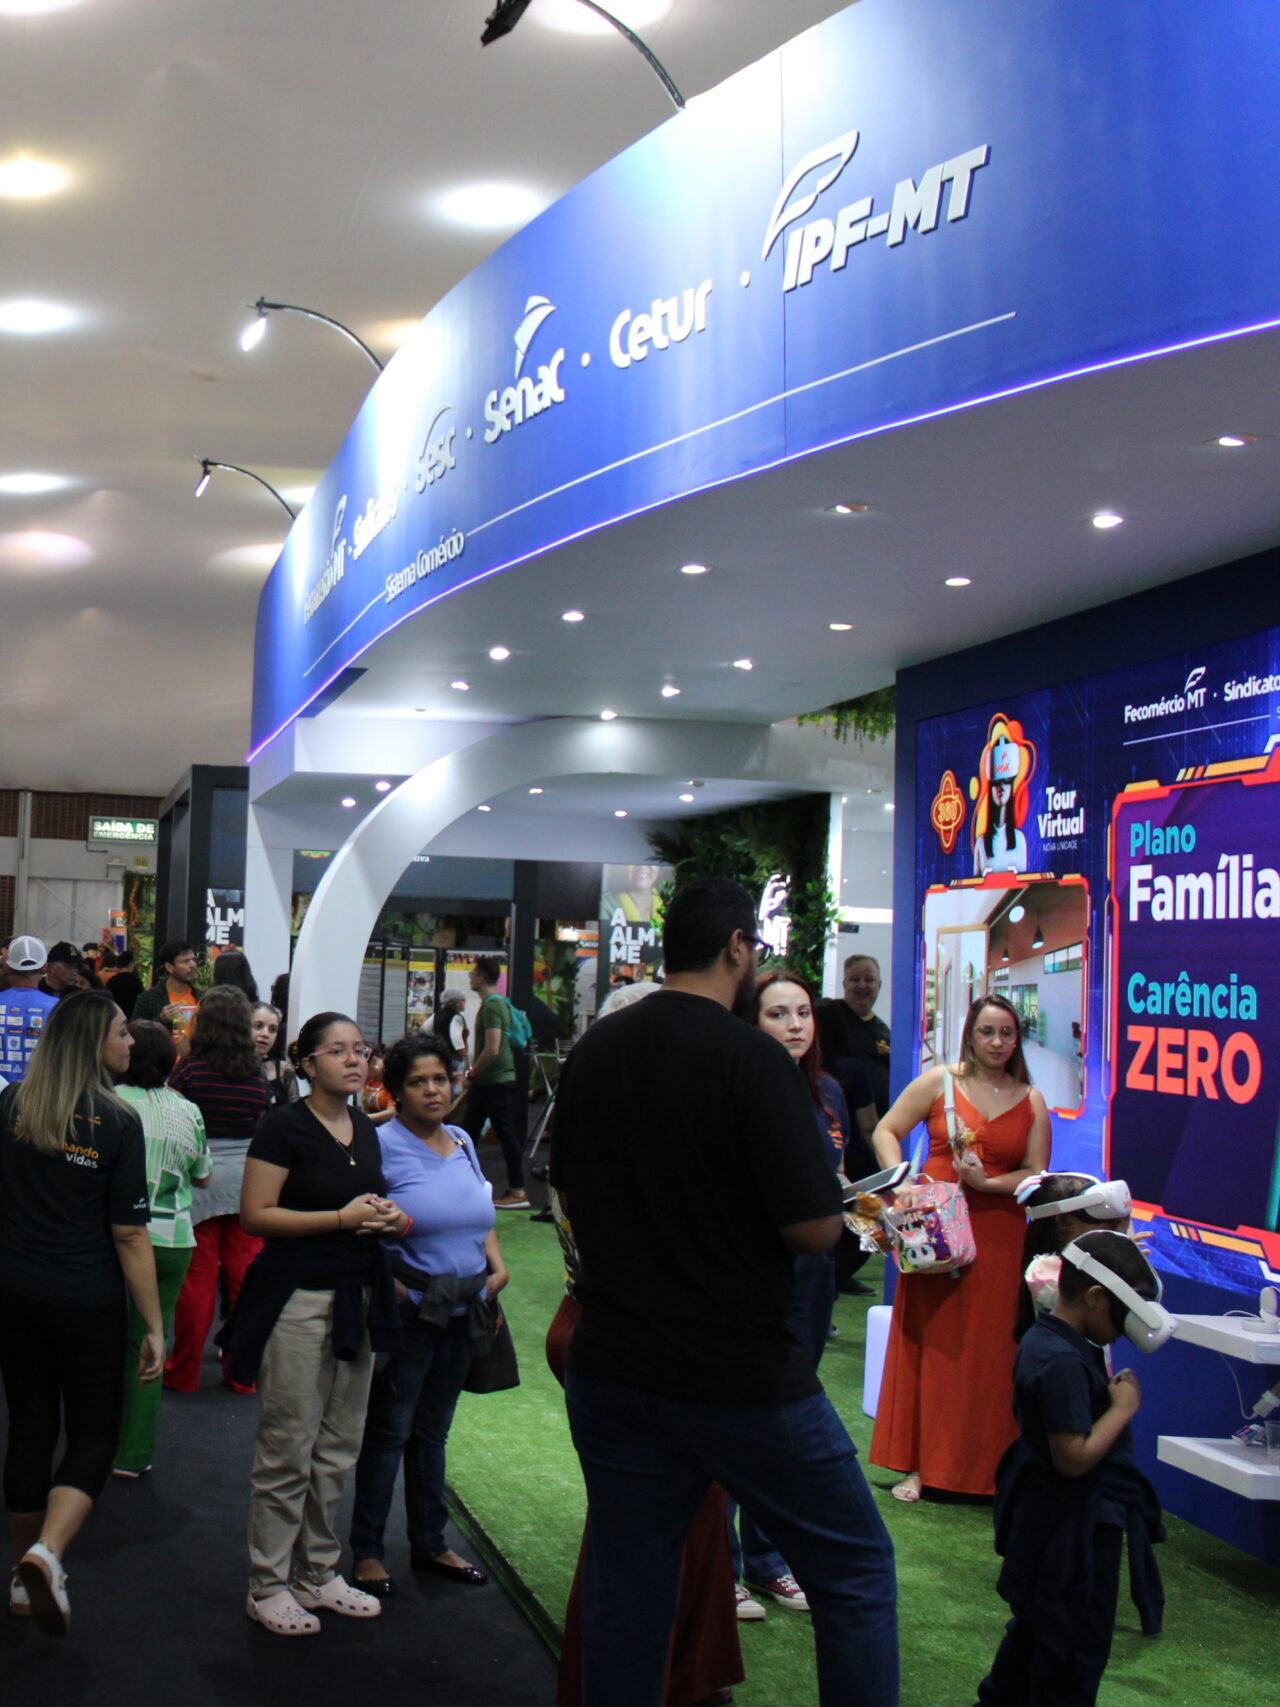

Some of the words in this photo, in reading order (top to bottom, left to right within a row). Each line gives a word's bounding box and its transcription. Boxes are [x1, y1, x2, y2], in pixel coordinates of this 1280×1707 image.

[484, 348, 565, 444] Senac
[610, 278, 713, 369] Cetur
[782, 143, 991, 293] IPF-MT
[386, 563, 416, 603] Sistema
[416, 528, 466, 579] Comércio
[1124, 694, 1185, 724] Fecomércio
[1187, 687, 1207, 711] MT
[1046, 787, 1077, 812] Tour
[93, 820, 134, 833] SAÍDA
[136, 822, 155, 834] DE
[1037, 808, 1085, 838] Virtual
[1130, 820, 1197, 857] Plano
[1129, 853, 1280, 922] Família
[610, 908, 627, 926] A
[609, 944, 641, 964] ME
[1127, 971, 1257, 1020] Carência
[1126, 1025, 1262, 1104] ZERO
[66, 1153, 98, 1169] vidas
